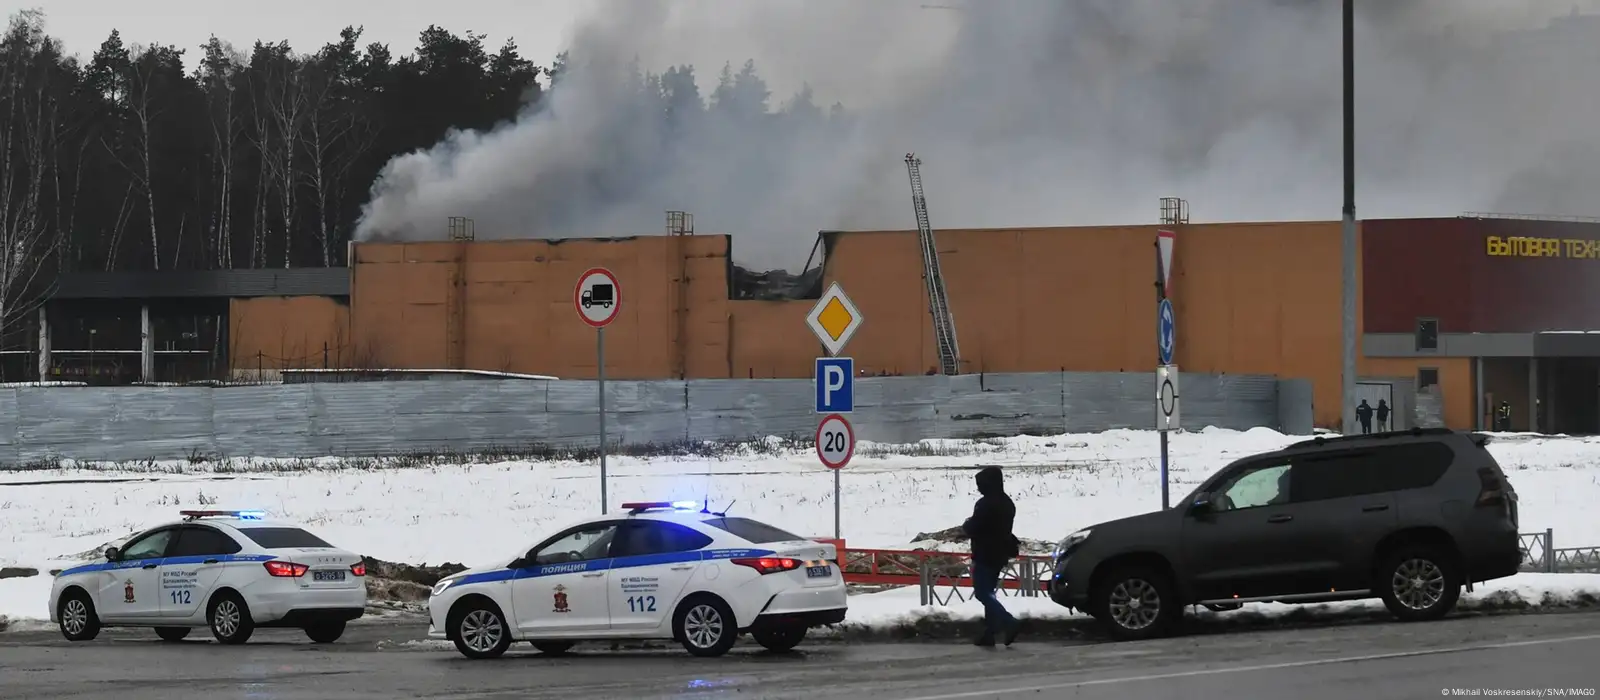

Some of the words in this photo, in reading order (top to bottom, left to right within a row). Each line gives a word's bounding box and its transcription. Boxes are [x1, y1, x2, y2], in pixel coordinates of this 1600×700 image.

[1486, 236, 1560, 257] БЫТОВАЯ
[824, 365, 845, 406] P
[824, 431, 845, 453] 20
[540, 562, 587, 574] ПОЛИЦИЯ
[170, 590, 191, 604] 112
[627, 595, 657, 612] 112
